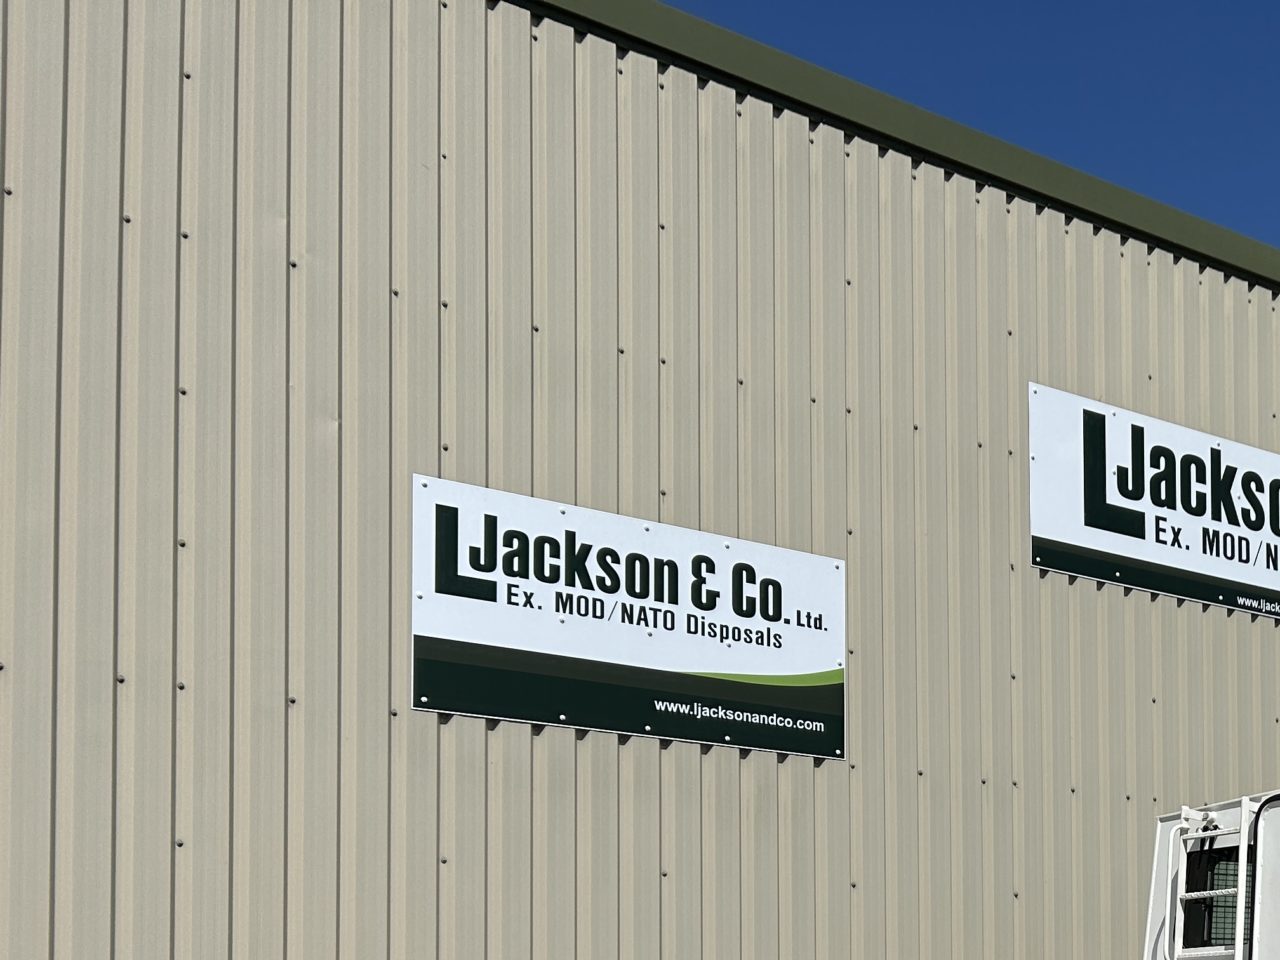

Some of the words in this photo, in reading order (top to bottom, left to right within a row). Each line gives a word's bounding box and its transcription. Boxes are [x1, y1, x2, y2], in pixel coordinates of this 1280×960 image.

[1154, 516, 1190, 550] Ex.
[506, 584, 543, 610] Ex.
[555, 592, 676, 632] MOD/NATO
[686, 614, 783, 649] Disposals
[691, 555, 721, 612] &
[731, 563, 791, 625] Co.
[796, 610, 828, 632] Ltd.
